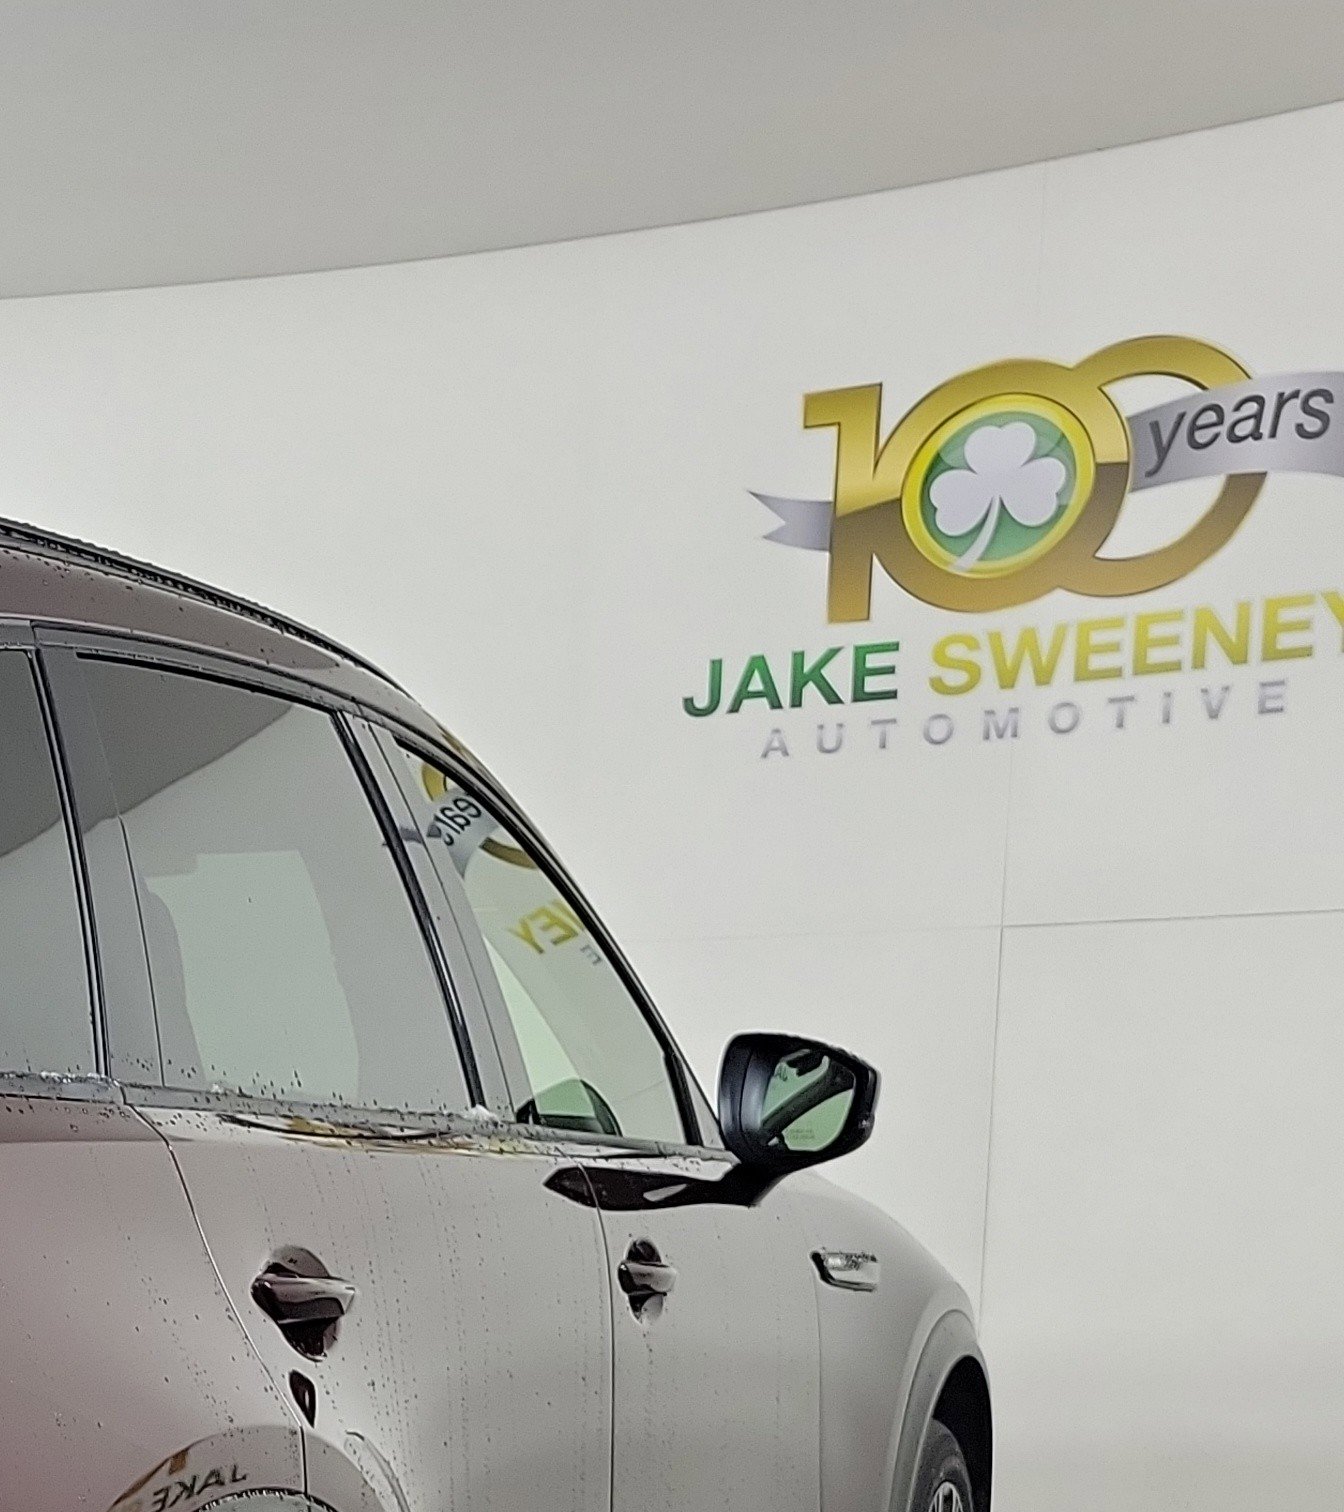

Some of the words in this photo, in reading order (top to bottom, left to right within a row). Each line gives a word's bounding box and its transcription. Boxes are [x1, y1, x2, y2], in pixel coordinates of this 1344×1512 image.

[1144, 385, 1336, 477] years
[803, 335, 1267, 625] 100
[682, 640, 901, 718] JAKE
[760, 678, 1289, 760] AUTOMOTIVE
